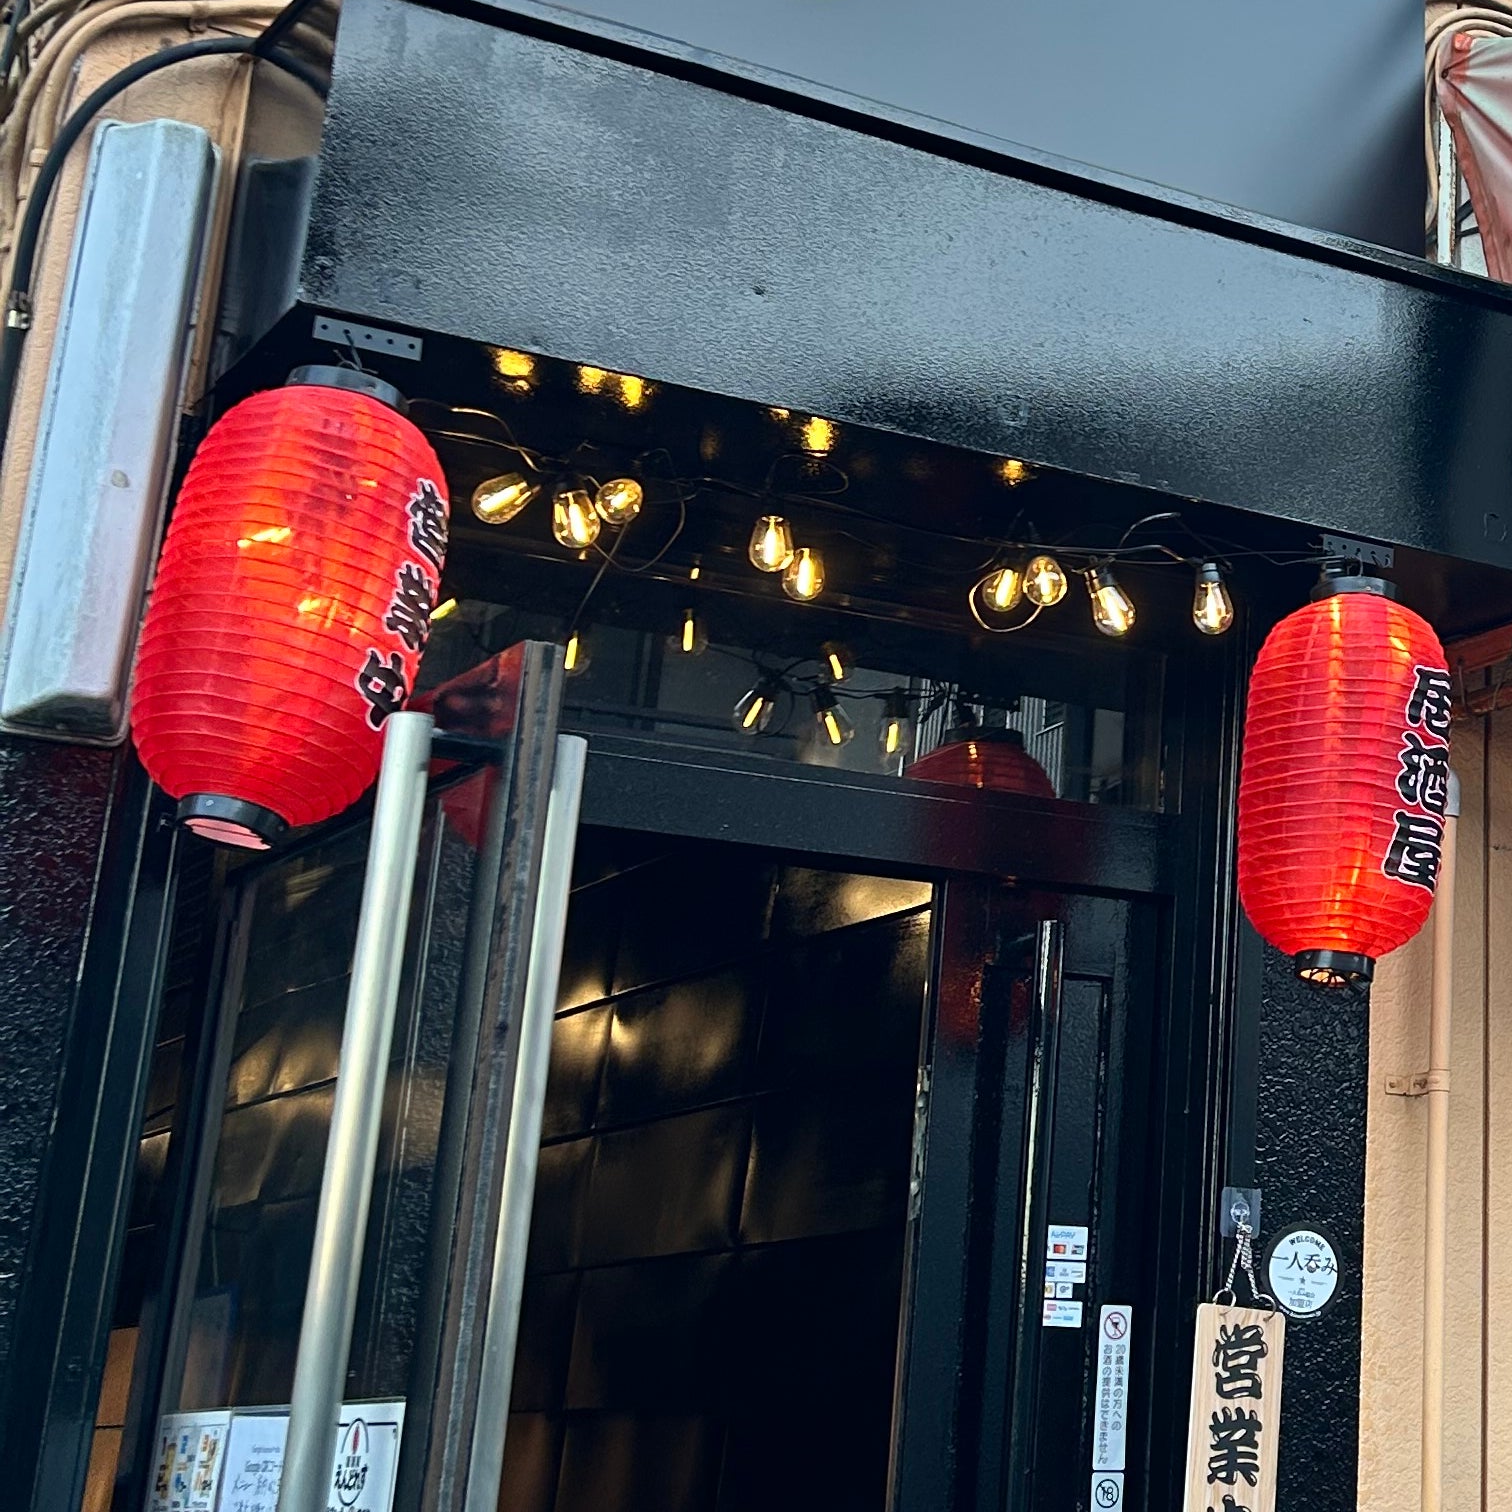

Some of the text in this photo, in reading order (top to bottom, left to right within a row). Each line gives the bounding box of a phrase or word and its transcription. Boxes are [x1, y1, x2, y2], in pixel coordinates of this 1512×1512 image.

[1382, 665, 1451, 894] 居酒屋
[1289, 1235, 1326, 1251] WELCOME
[1207, 1324, 1268, 1512] 営業
